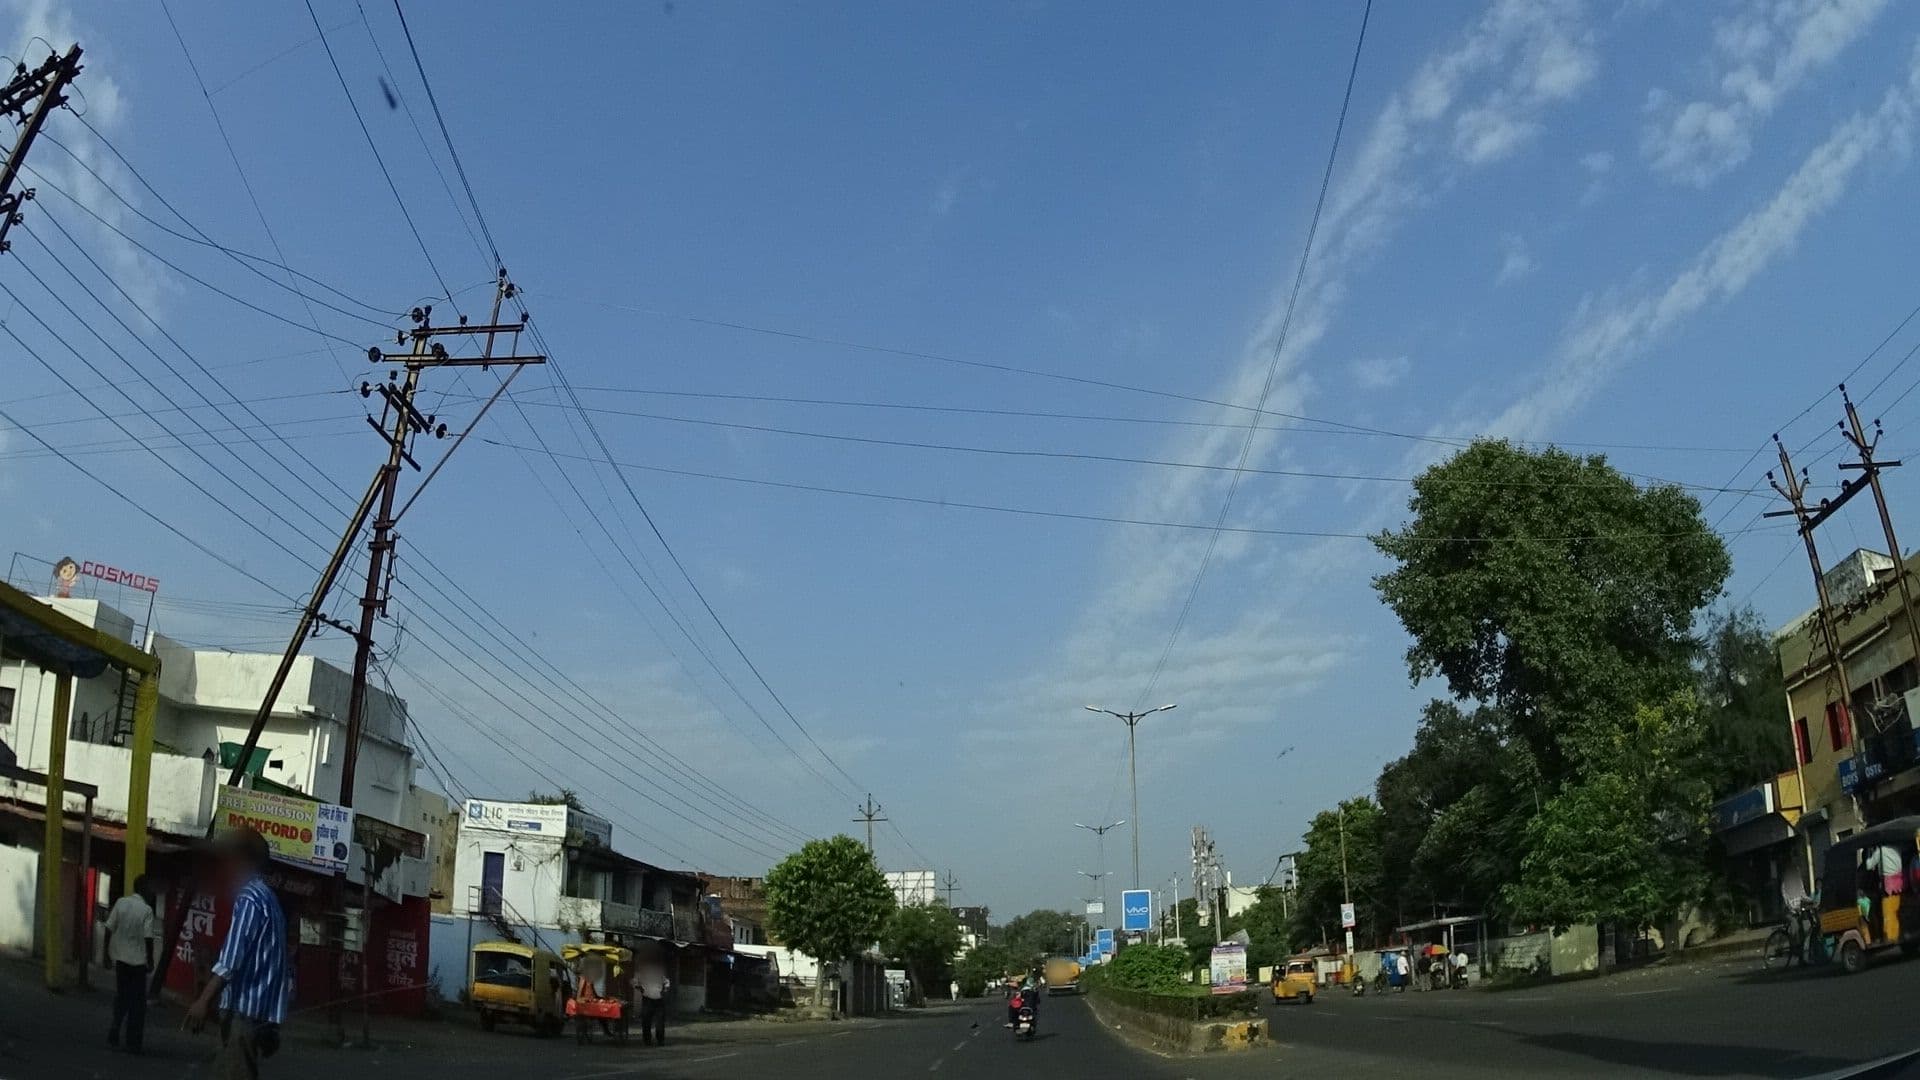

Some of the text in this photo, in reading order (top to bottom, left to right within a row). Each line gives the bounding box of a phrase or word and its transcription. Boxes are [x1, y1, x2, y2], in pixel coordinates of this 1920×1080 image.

[81, 561, 160, 592] COSMOS
[220, 796, 245, 809] FREE
[251, 804, 313, 823] ADMISSION
[484, 806, 502, 820] LIC
[229, 813, 299, 840] ROCKFORD
[1126, 906, 1148, 914] vivo
